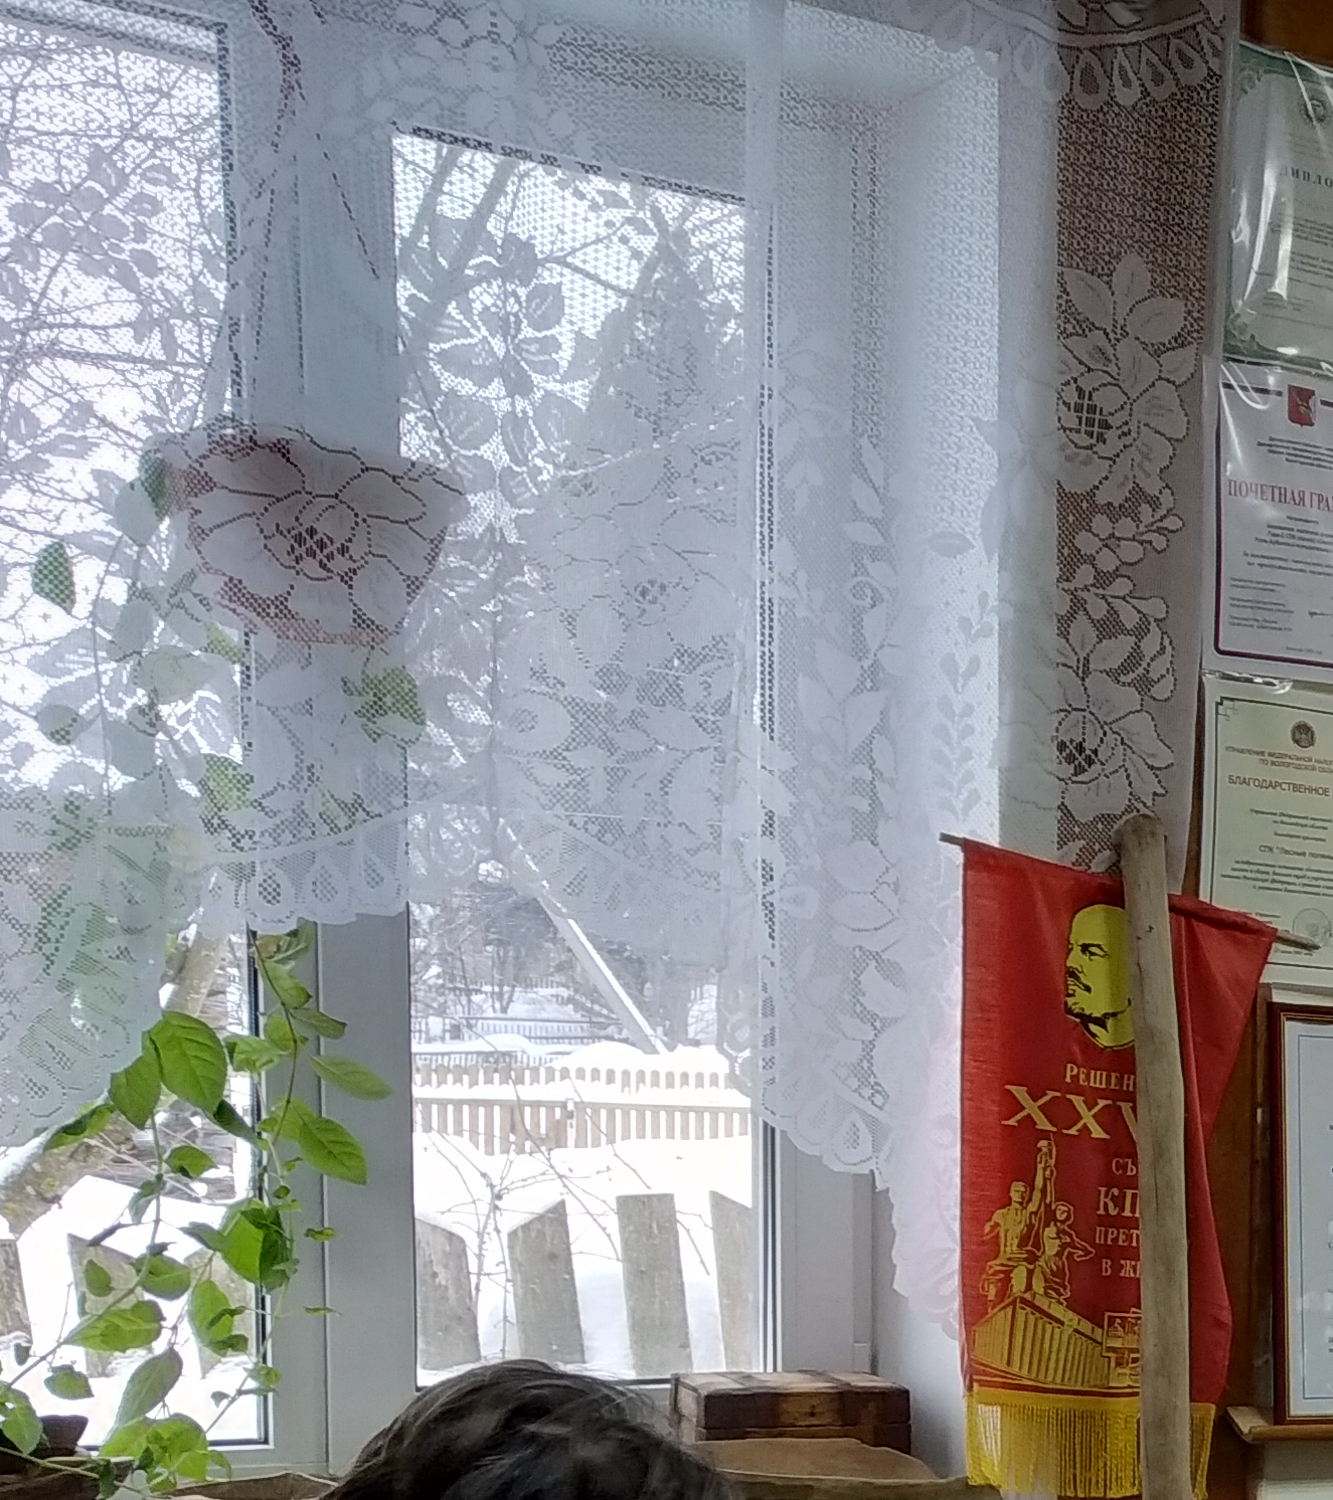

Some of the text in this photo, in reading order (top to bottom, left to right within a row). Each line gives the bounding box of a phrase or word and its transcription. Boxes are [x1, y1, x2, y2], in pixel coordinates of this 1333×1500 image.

[1227, 479, 1306, 509] ПОЧЕТНАЯ
[1228, 774, 1330, 797] БЛАГОДАРСТВЕННОЕ
[1064, 1063, 1135, 1092] РЕШЕН
[1111, 1157, 1137, 1176] СЪ
[1096, 1187, 1140, 1218] КП
[1095, 1226, 1140, 1247] ПРЕТ
[1101, 1258, 1112, 1277] В
